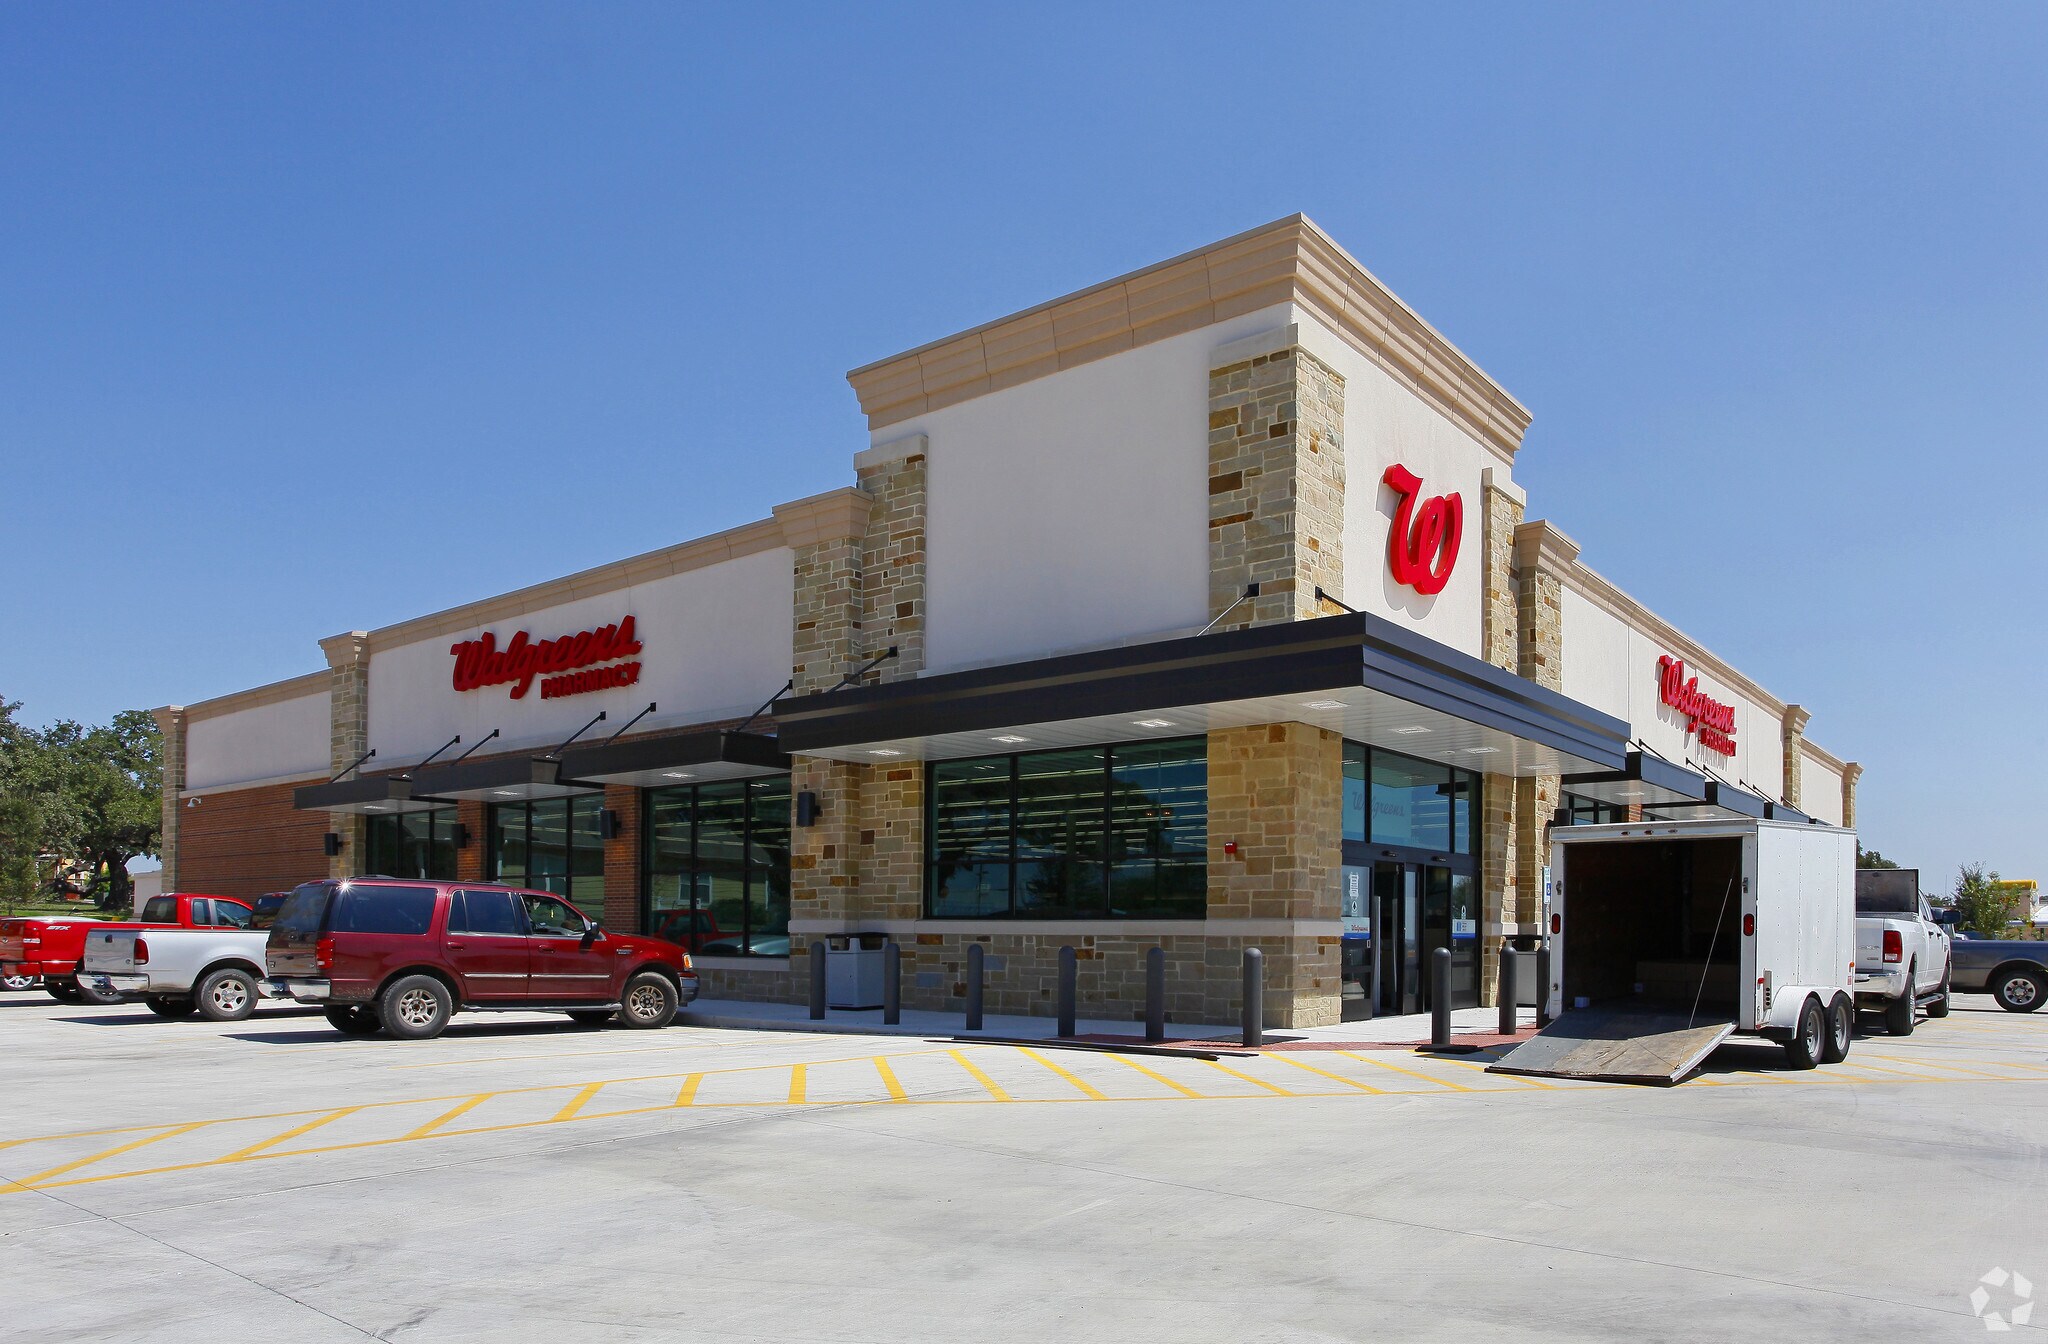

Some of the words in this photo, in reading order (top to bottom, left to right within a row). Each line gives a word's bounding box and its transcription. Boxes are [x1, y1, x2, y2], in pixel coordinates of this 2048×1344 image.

[450, 614, 642, 699] Walgreens
[540, 661, 641, 699] PHARMACY
[1659, 655, 1737, 735] Walgreens
